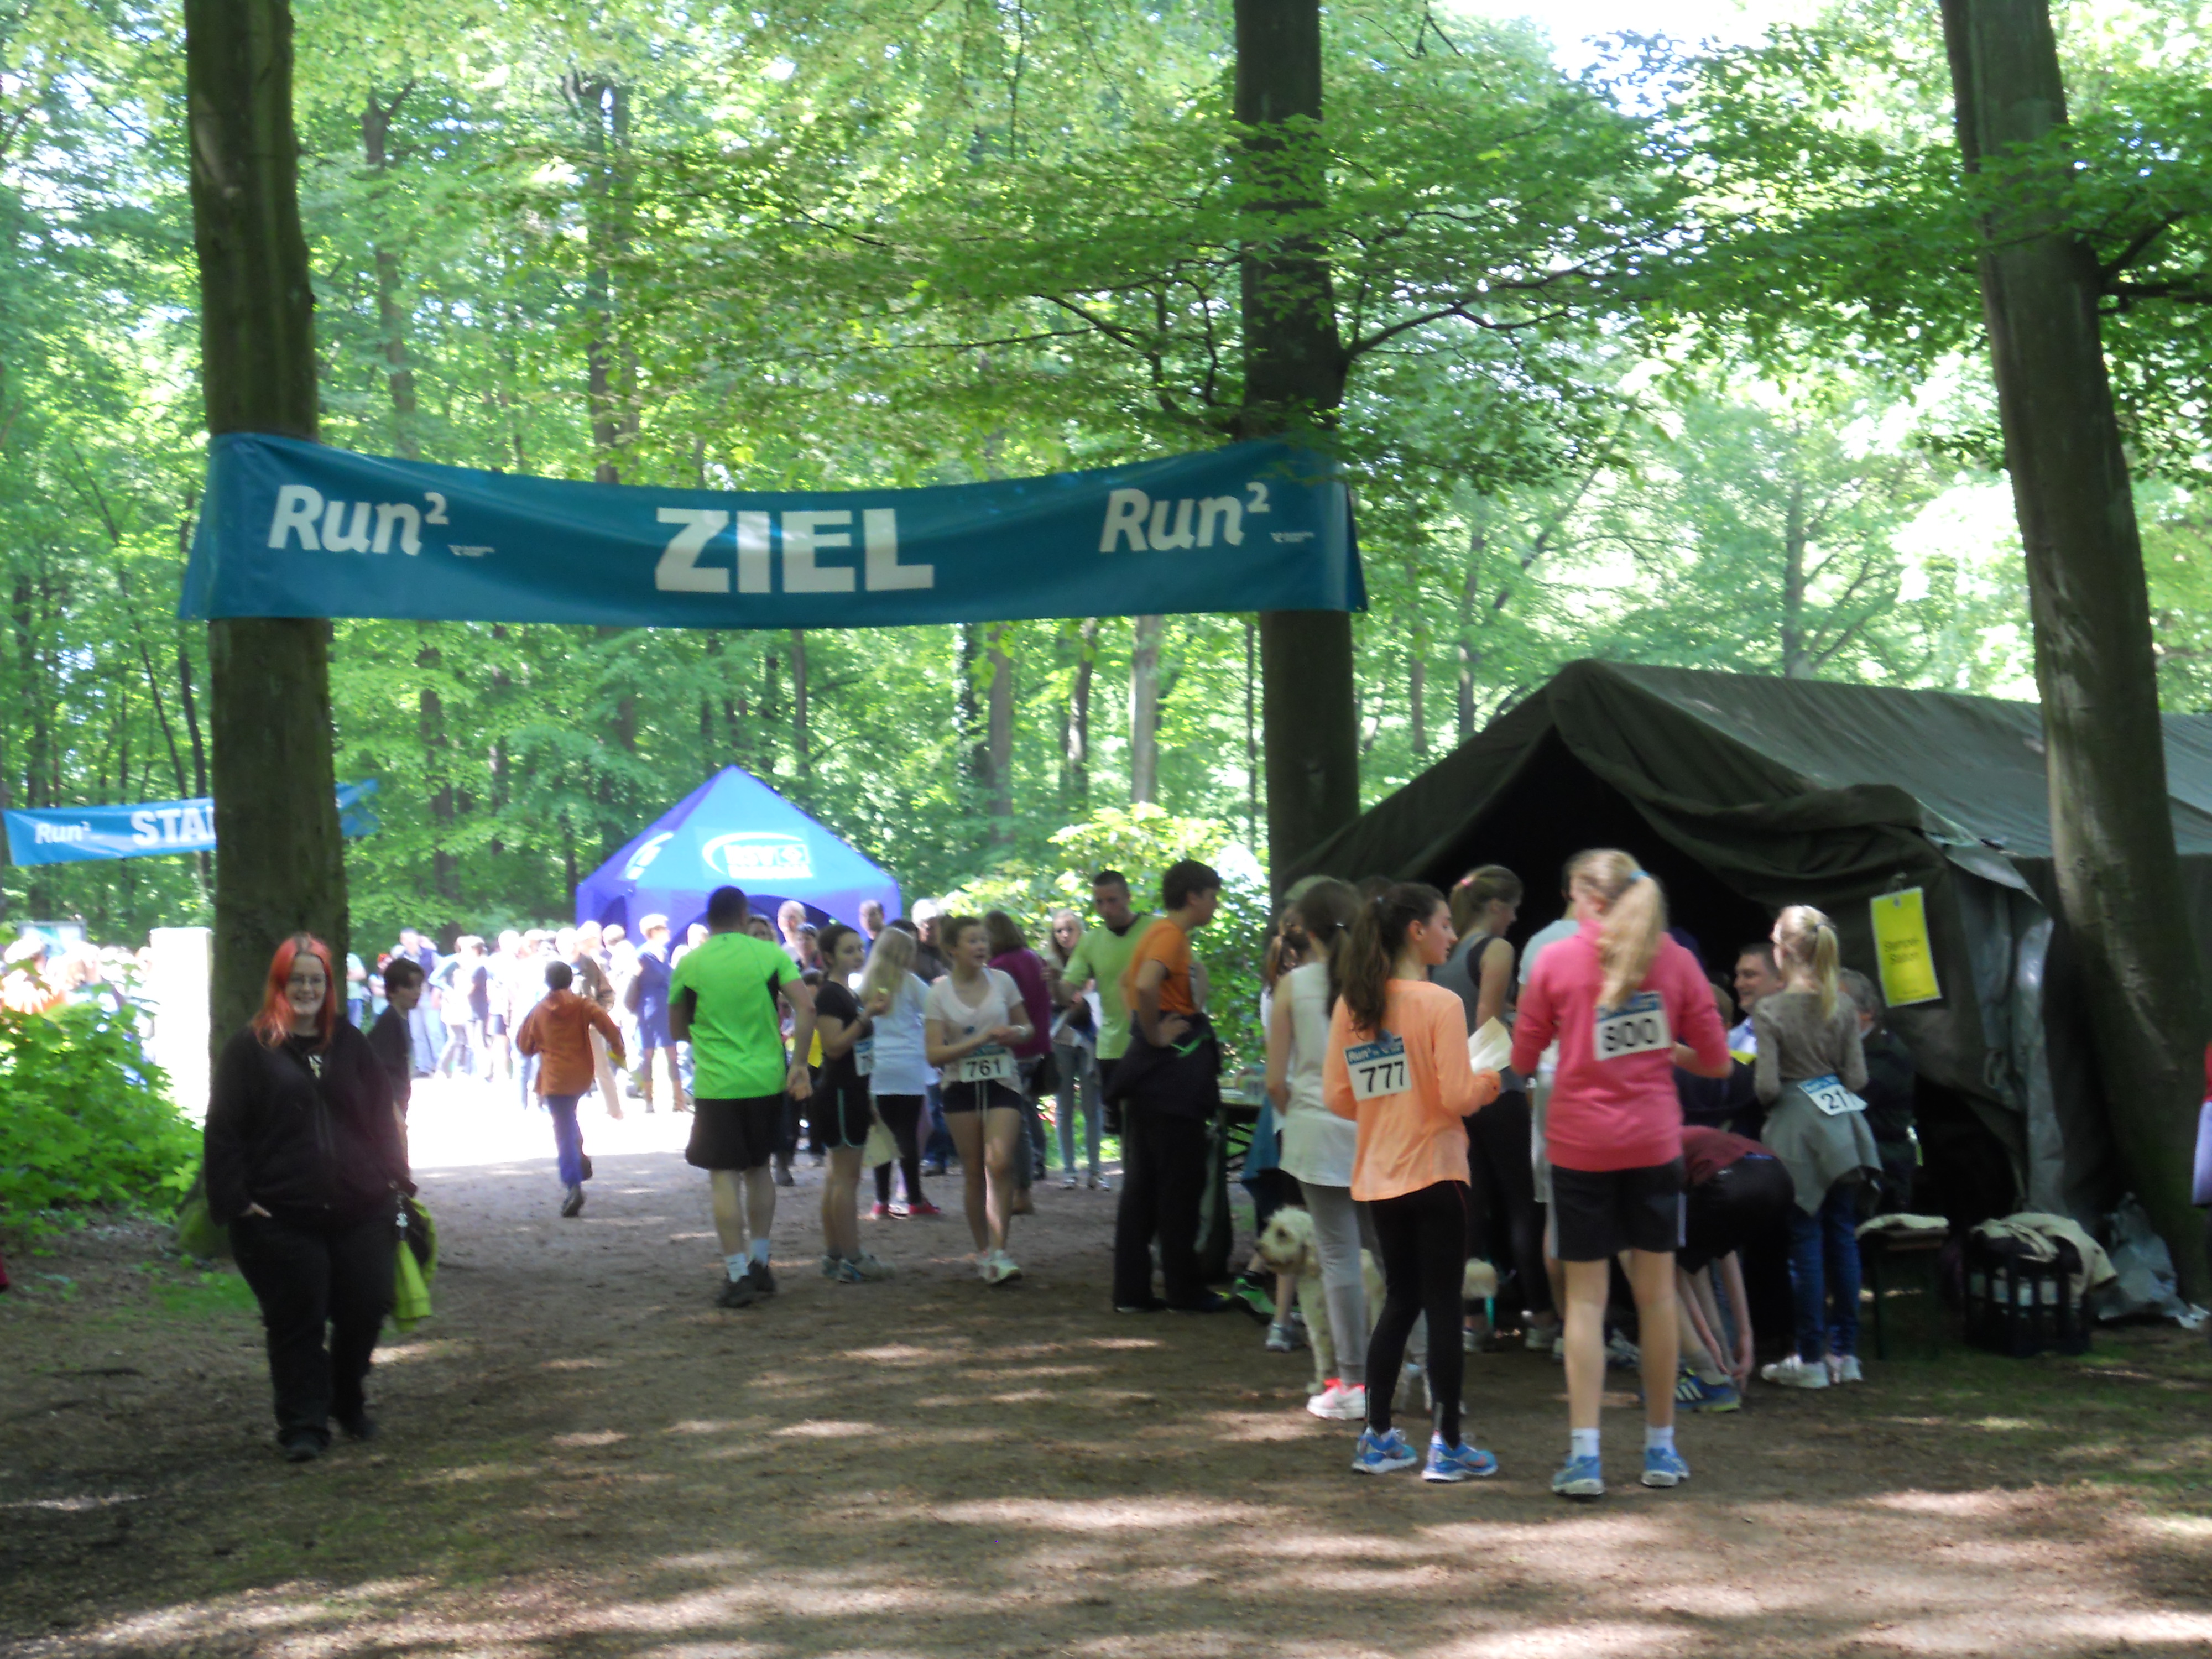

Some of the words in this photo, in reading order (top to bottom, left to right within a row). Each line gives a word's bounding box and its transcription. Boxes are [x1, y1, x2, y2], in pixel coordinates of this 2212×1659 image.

[654, 507, 934, 593] ZIEL
[966, 1058, 1001, 1077] 761
[1359, 1060, 1404, 1092] 777
